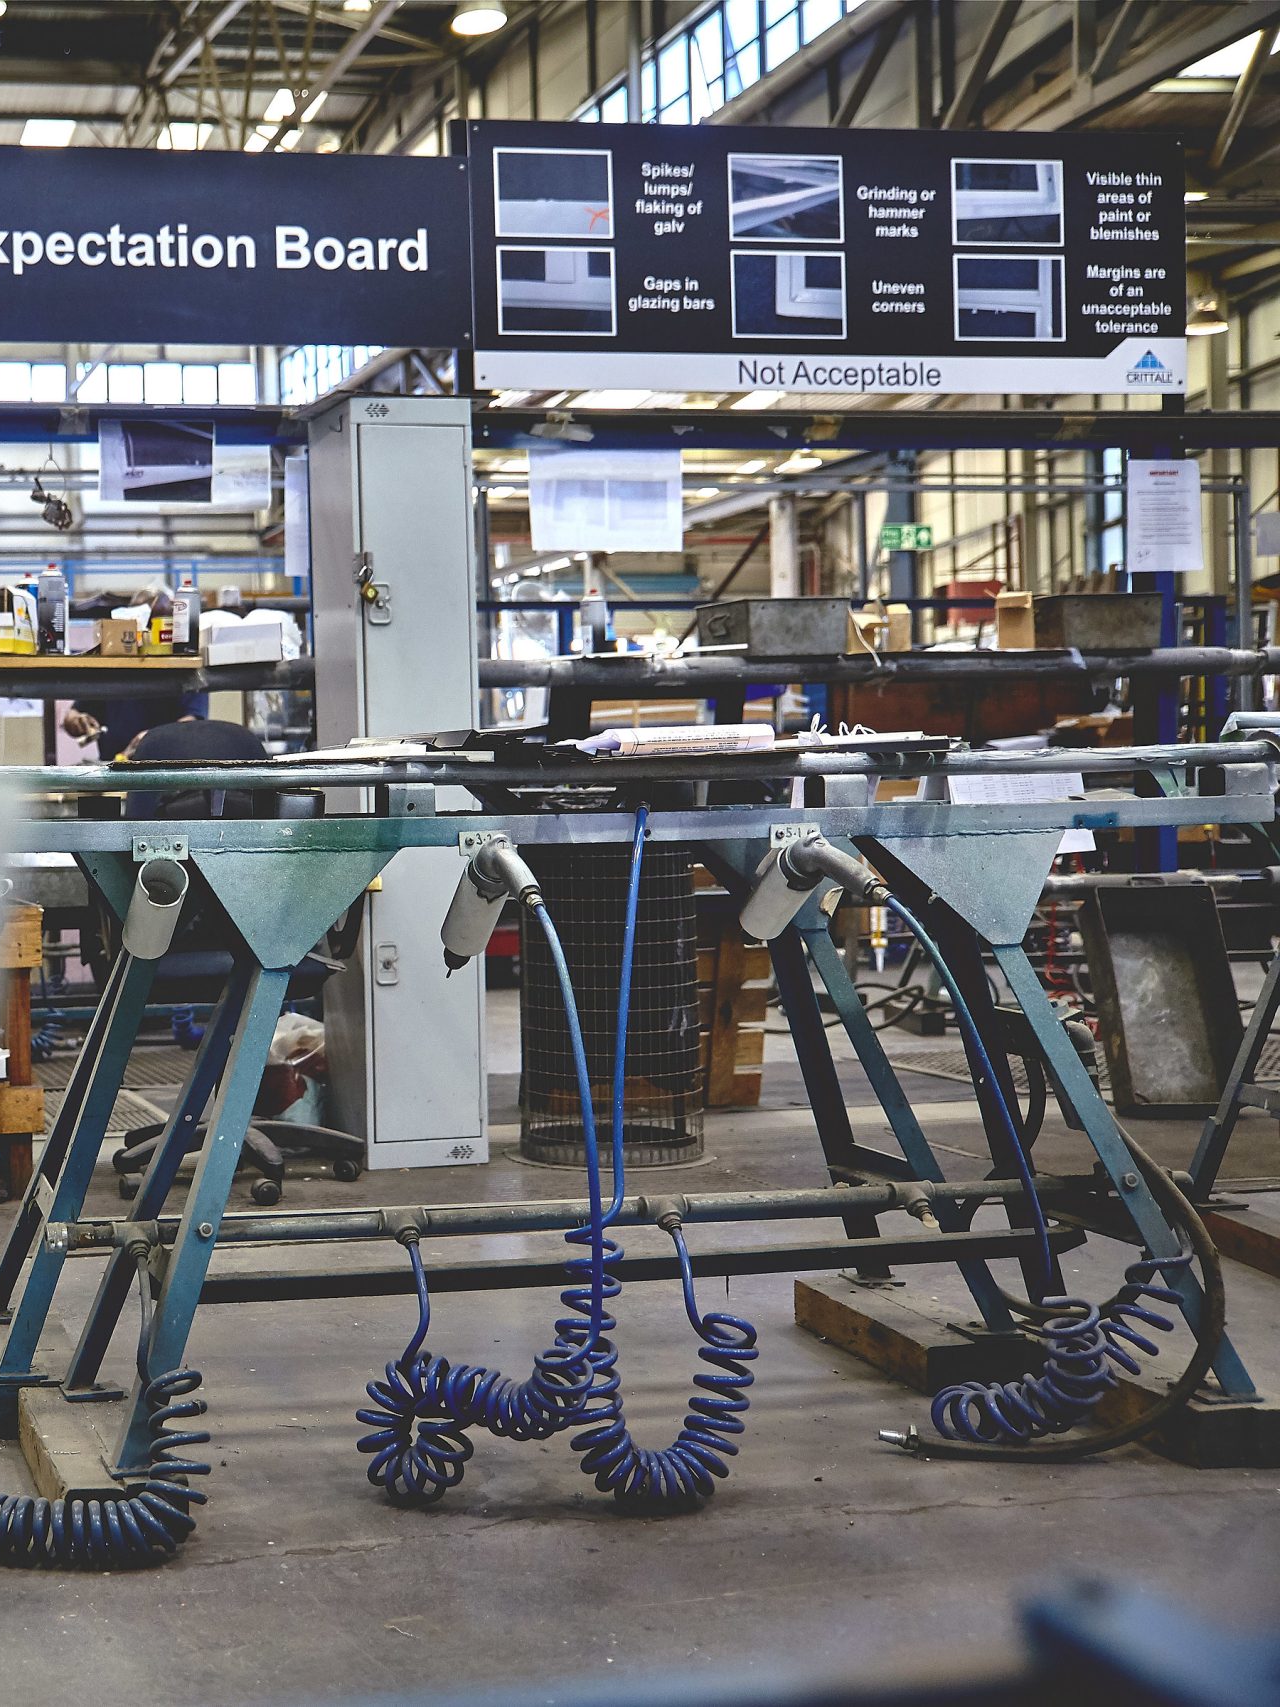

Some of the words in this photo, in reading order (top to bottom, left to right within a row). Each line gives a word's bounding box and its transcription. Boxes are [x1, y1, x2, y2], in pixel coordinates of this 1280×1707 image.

[642, 163, 694, 179] Spikes/
[1087, 171, 1132, 186] Visible
[1136, 173, 1161, 185] thin
[644, 182, 693, 199] lumps/
[857, 186, 917, 202] Grinding
[920, 190, 936, 201] or
[1097, 193, 1134, 204] areas
[1138, 191, 1152, 204] of
[635, 201, 684, 217] flaking
[687, 201, 703, 214] of
[869, 204, 925, 218] hammer
[1099, 209, 1133, 224] paint
[1137, 212, 1151, 222] or
[654, 219, 685, 235] galv
[876, 224, 918, 237] marks
[1091, 226, 1159, 240] blemishes
[276, 226, 428, 271] Board
[1087, 265, 1140, 281] Margins
[1145, 269, 1165, 279] are
[644, 276, 681, 293] Gaps
[685, 277, 698, 291] in
[872, 280, 924, 294] Uneven
[1110, 284, 1124, 296] of
[1127, 287, 1143, 296] an
[629, 295, 679, 312] glazing
[683, 296, 714, 310] bars
[872, 302, 925, 313] corners
[1082, 302, 1171, 317] unacceptable
[1096, 320, 1158, 333] tolerance
[737, 360, 784, 385] Not
[791, 361, 942, 391] Acceptable
[1126, 372, 1173, 384] CRITTALL
